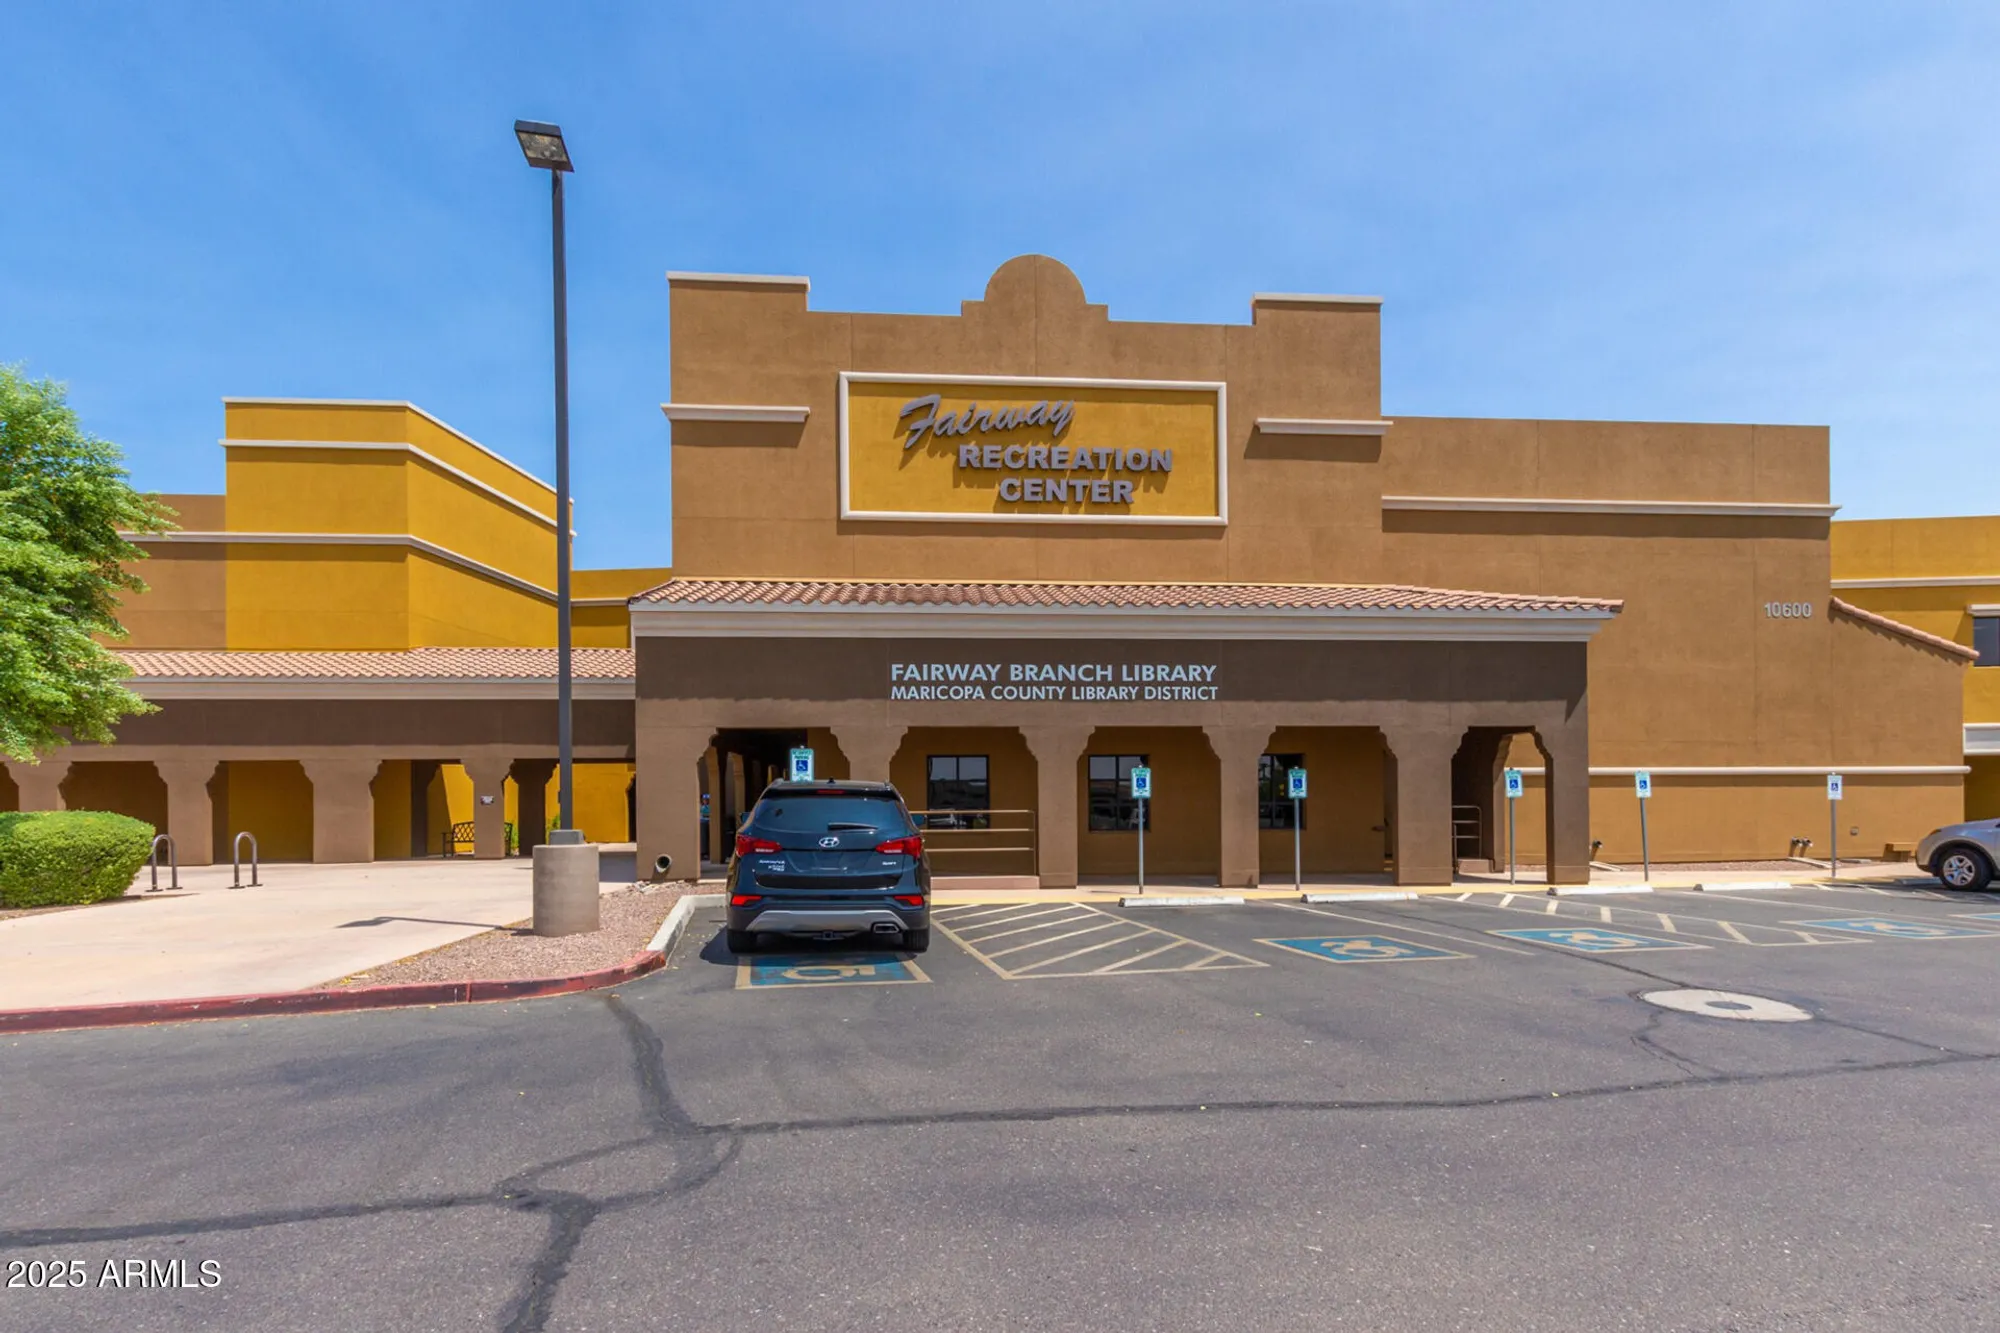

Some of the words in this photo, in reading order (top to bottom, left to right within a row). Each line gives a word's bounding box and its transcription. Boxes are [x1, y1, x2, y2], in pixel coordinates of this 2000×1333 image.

[899, 394, 1075, 450] Fairway
[958, 444, 1172, 473] RECREATION
[999, 477, 1133, 504] CENTER
[1764, 602, 1812, 618] 10600
[891, 664, 1002, 682] FAIRWAY
[1010, 664, 1113, 682] BRANCH
[1121, 665, 1217, 682] LIBRARY
[891, 686, 985, 700] MARICOPA
[991, 686, 1065, 700] COUNTY
[1071, 686, 1138, 700] LIBRARY
[1144, 686, 1218, 700] DISTRICT
